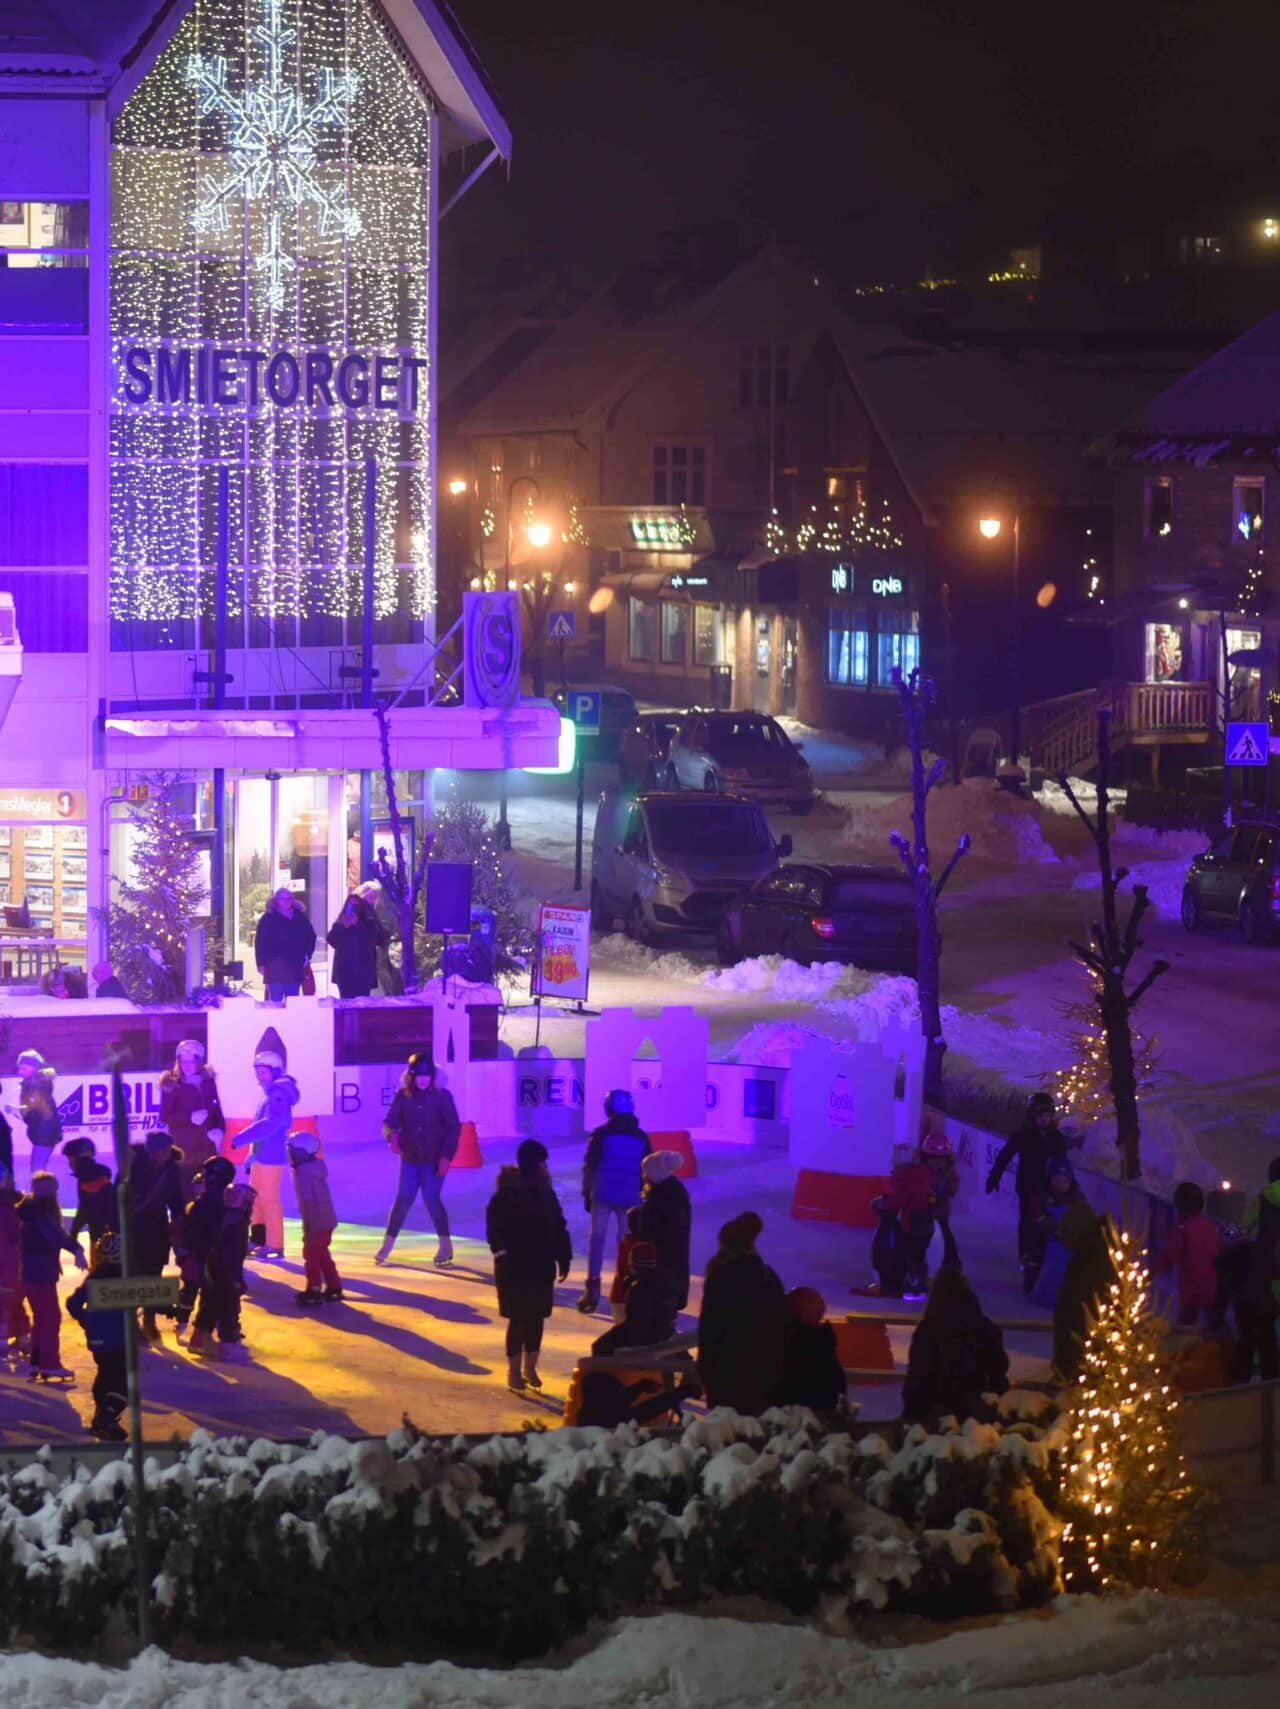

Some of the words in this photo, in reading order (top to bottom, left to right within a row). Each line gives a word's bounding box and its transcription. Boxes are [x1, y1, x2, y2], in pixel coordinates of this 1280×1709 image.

[125, 348, 427, 410] SMIETORGET
[873, 576, 902, 597] DNB
[575, 695, 594, 721] P
